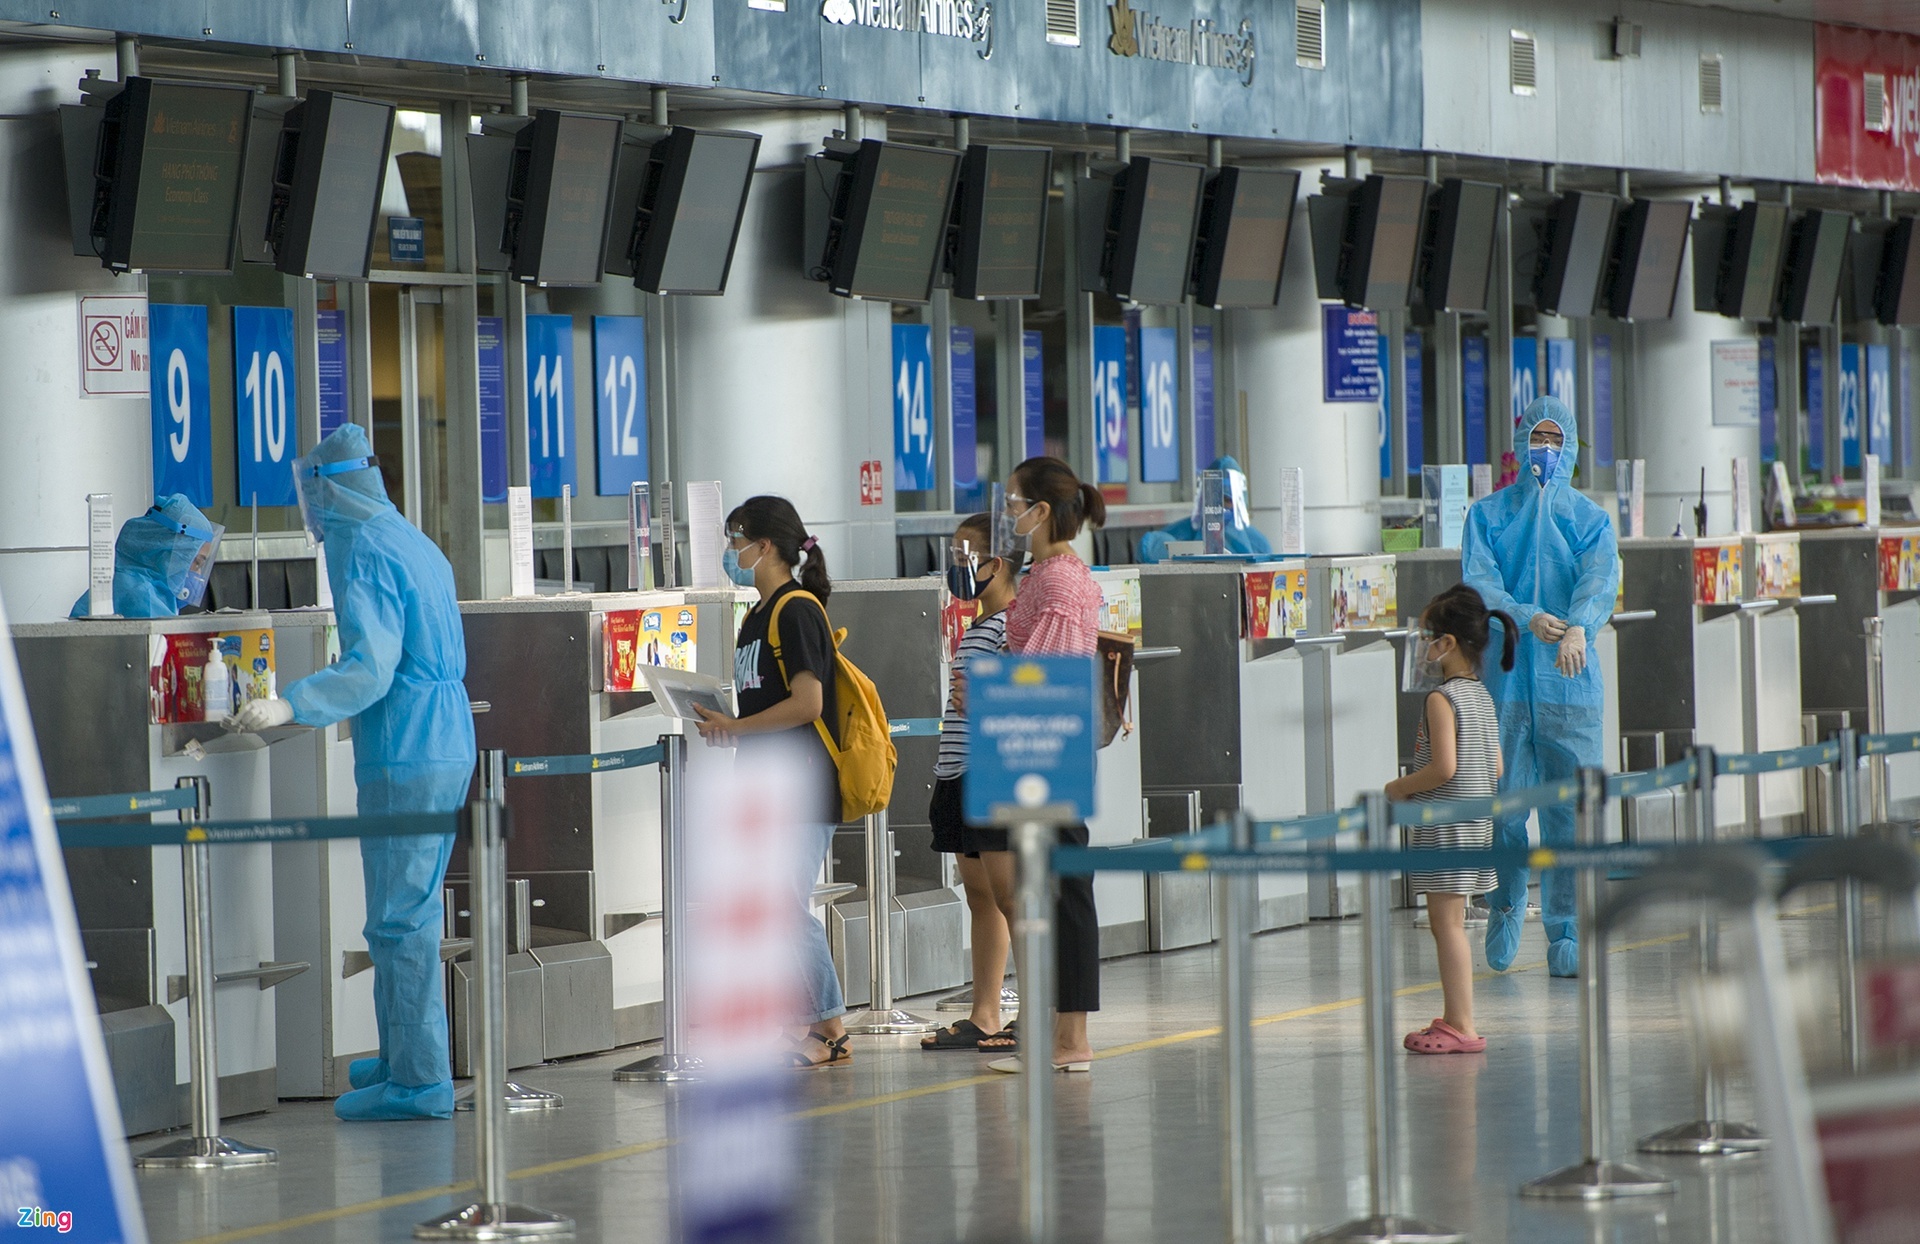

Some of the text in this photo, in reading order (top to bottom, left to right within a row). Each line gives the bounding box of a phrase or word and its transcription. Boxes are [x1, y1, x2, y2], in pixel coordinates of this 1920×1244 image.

[1135, 10, 1238, 69] Vietnam Airlines
[165, 186, 209, 207] Economy Class
[131, 350, 141, 372] No
[1095, 361, 1124, 448] 15
[1146, 361, 1173, 448] 16
[1871, 369, 1891, 440] 24
[168, 347, 191, 463] 9
[245, 350, 286, 463] 10
[534, 355, 565, 458] 11
[605, 355, 639, 456] 12
[898, 361, 928, 454] 14
